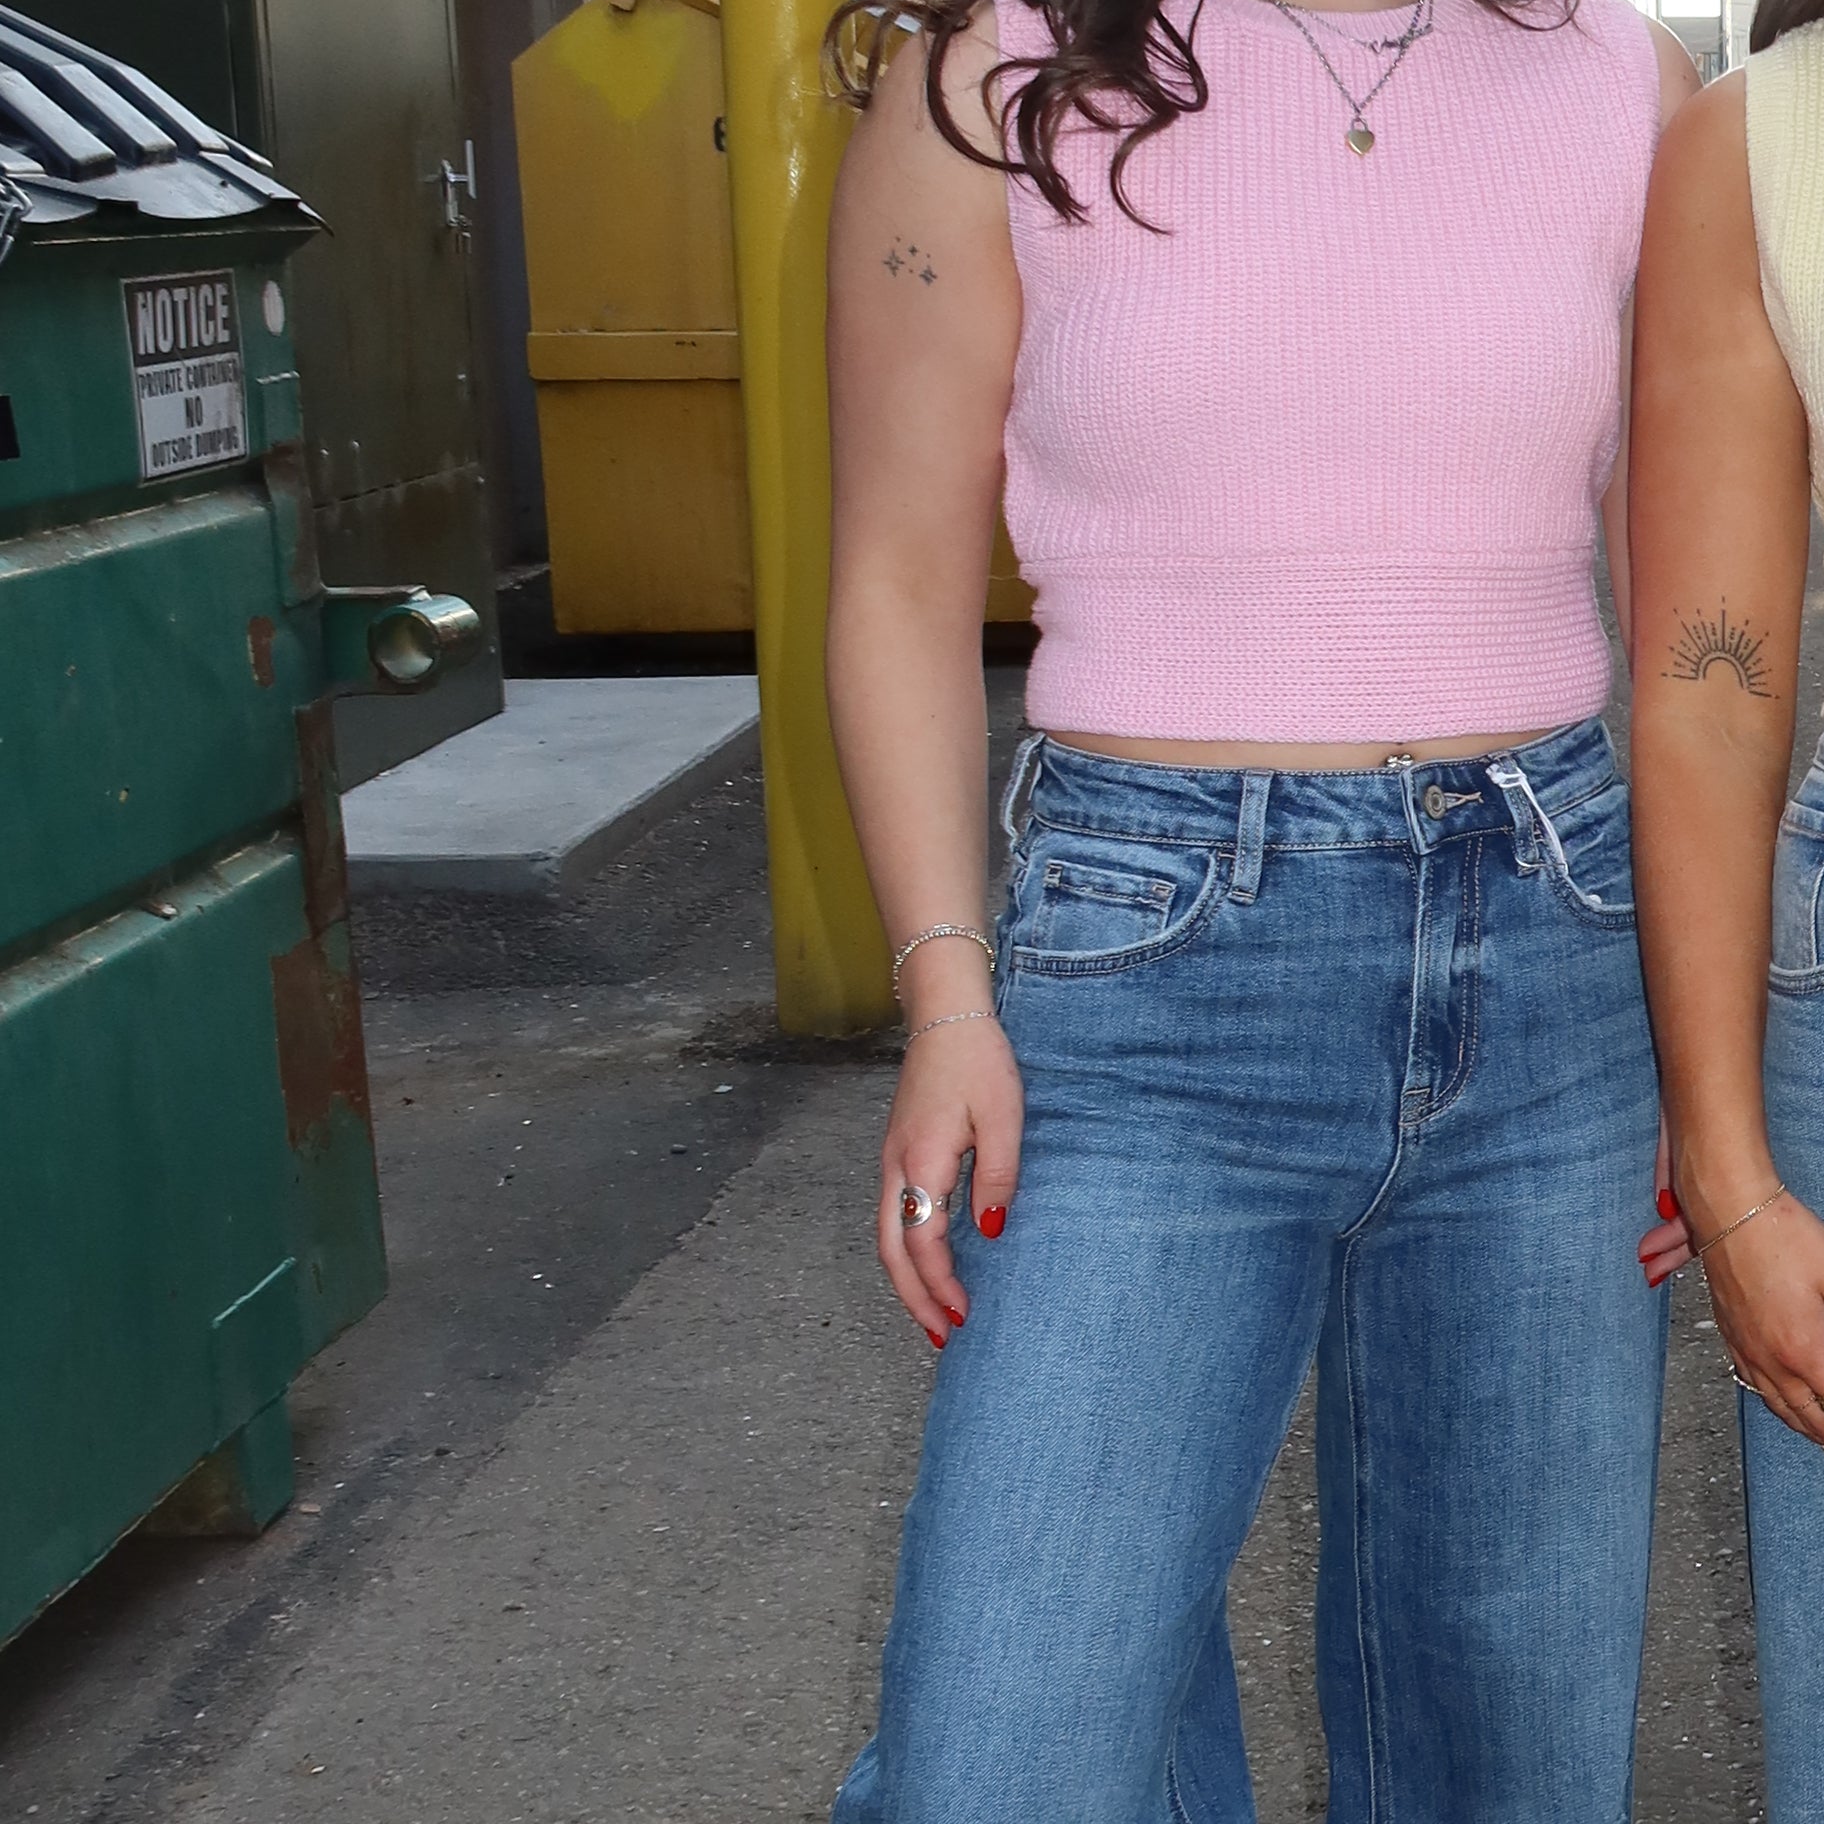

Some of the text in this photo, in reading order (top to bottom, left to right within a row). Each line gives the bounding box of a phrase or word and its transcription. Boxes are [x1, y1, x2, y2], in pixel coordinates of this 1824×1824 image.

[135, 282, 231, 355] NOTICE
[139, 367, 184, 399] PRIVATE
[185, 396, 204, 429] NO
[152, 426, 239, 468] OUTSIDE DUMPING
